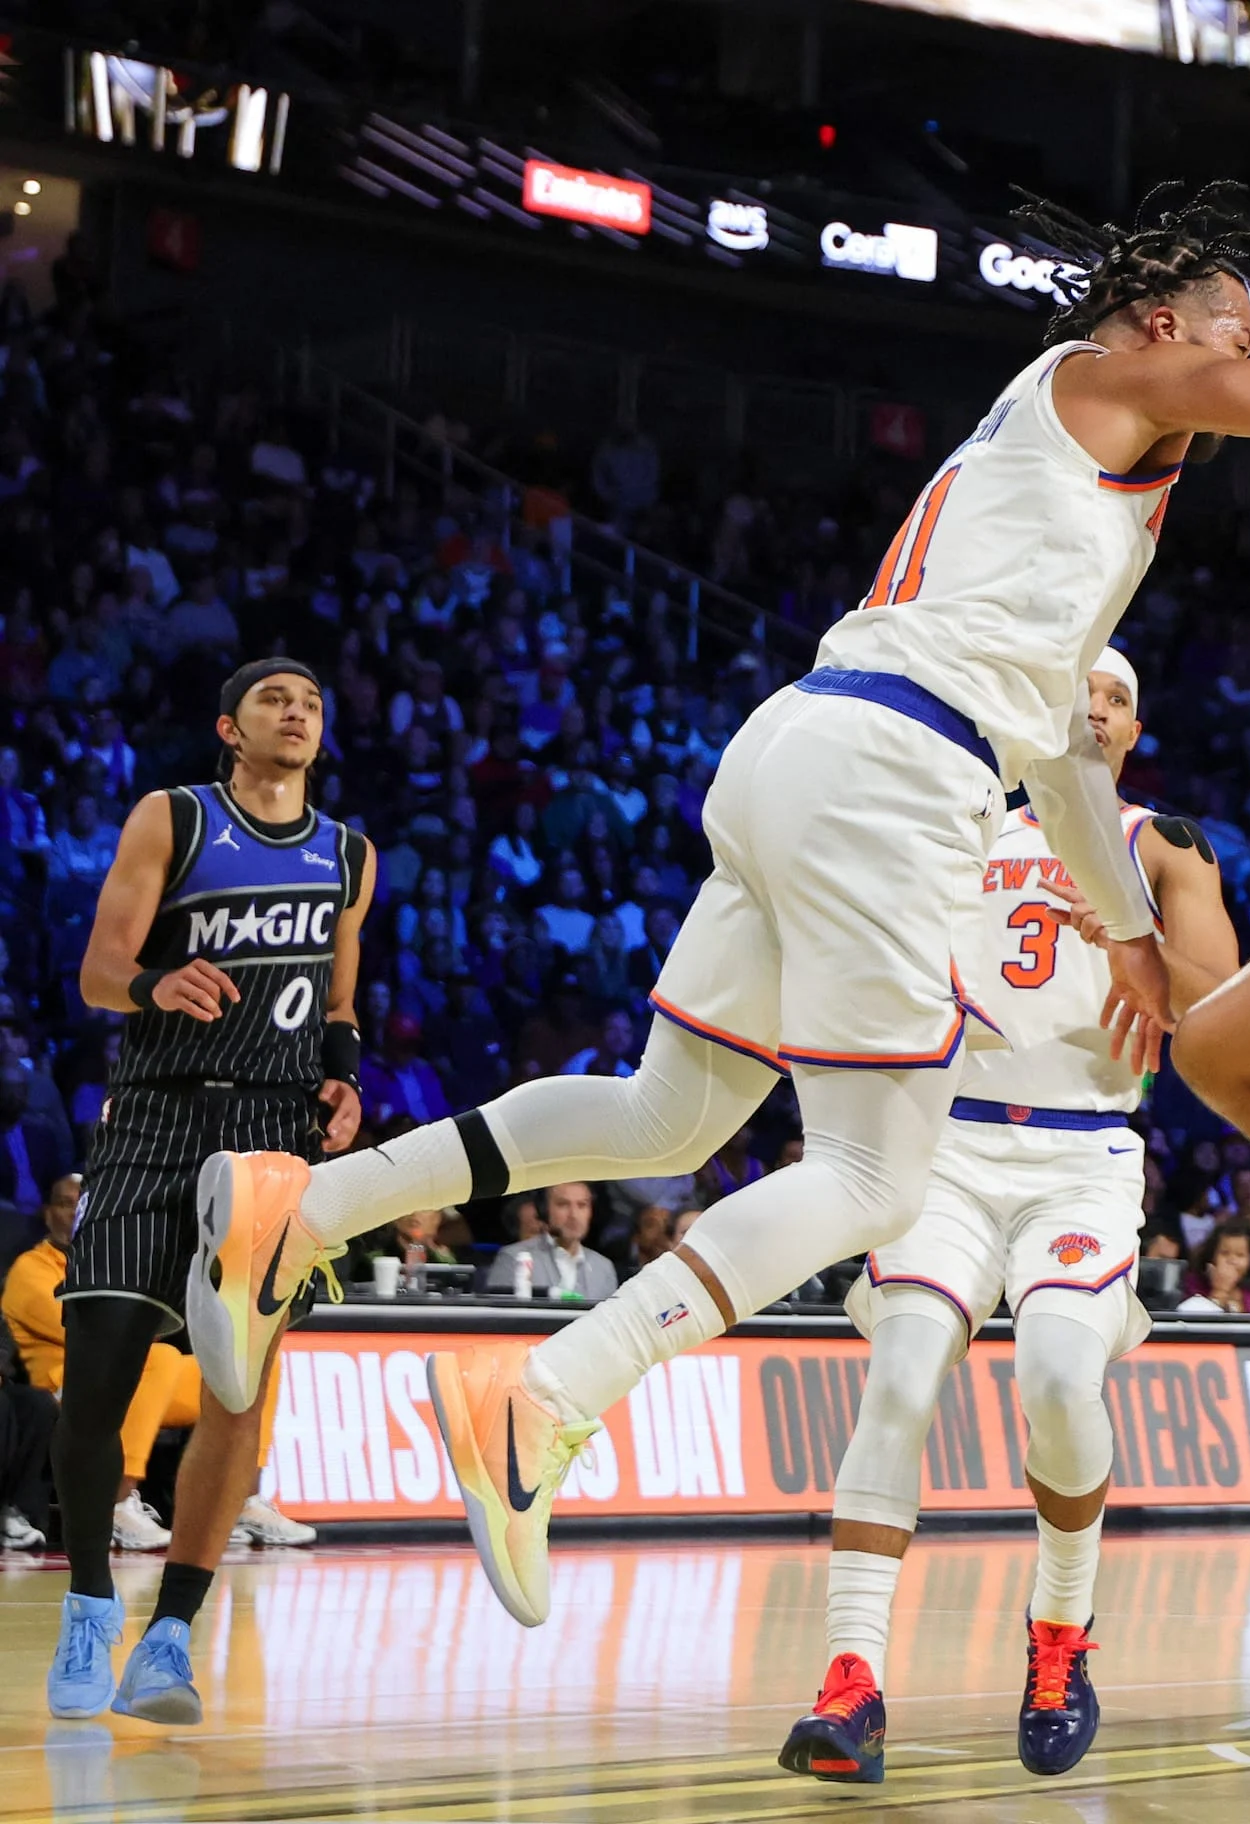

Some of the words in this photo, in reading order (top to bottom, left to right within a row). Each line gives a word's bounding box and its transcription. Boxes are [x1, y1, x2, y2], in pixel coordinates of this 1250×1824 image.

[863, 462, 962, 608] 11
[301, 849, 335, 870] Disney
[983, 859, 1037, 893] EW
[1001, 901, 1060, 989] 3
[273, 976, 314, 1030] 0
[629, 1355, 746, 1497] DAY
